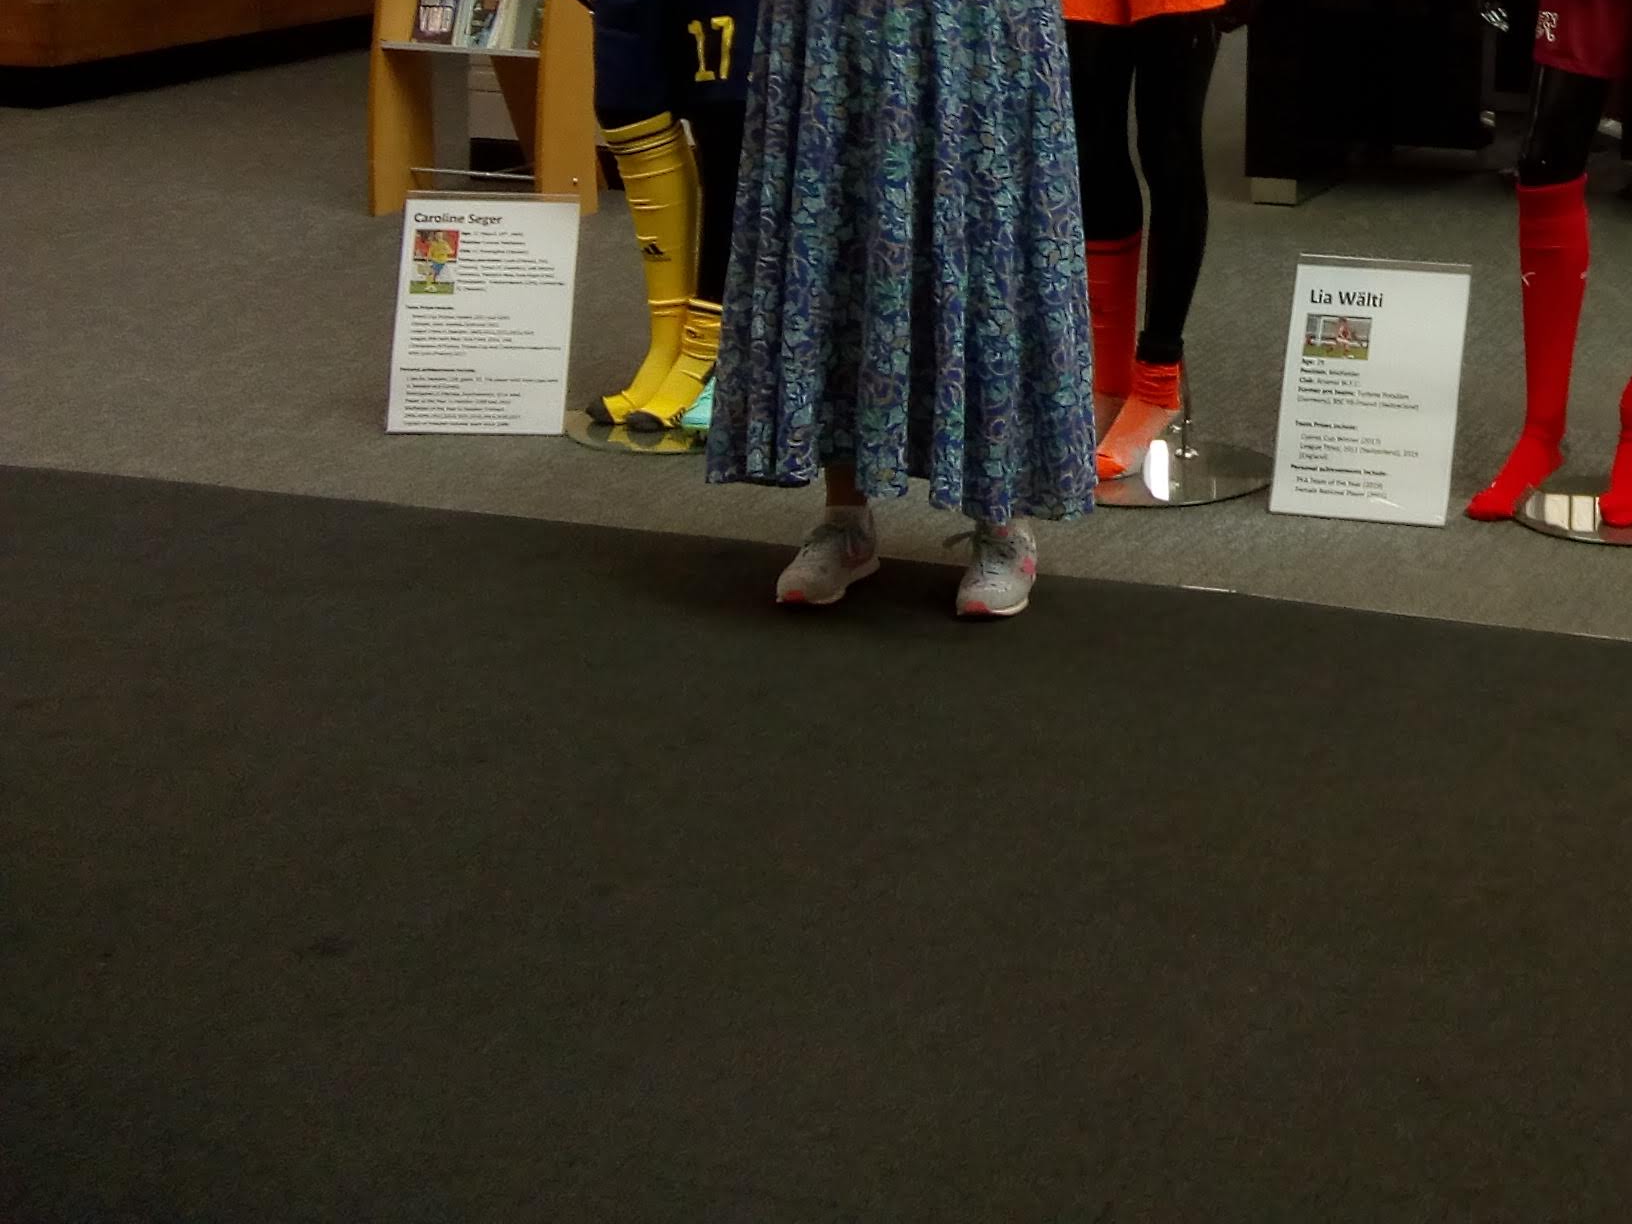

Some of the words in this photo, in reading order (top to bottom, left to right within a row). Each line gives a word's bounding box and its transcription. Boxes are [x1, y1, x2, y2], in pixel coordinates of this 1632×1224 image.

[687, 16, 735, 82] 17
[414, 212, 465, 225] Caroline
[468, 213, 503, 227] Seger
[1310, 289, 1332, 305] Lia
[1338, 290, 1384, 308] Wälti
